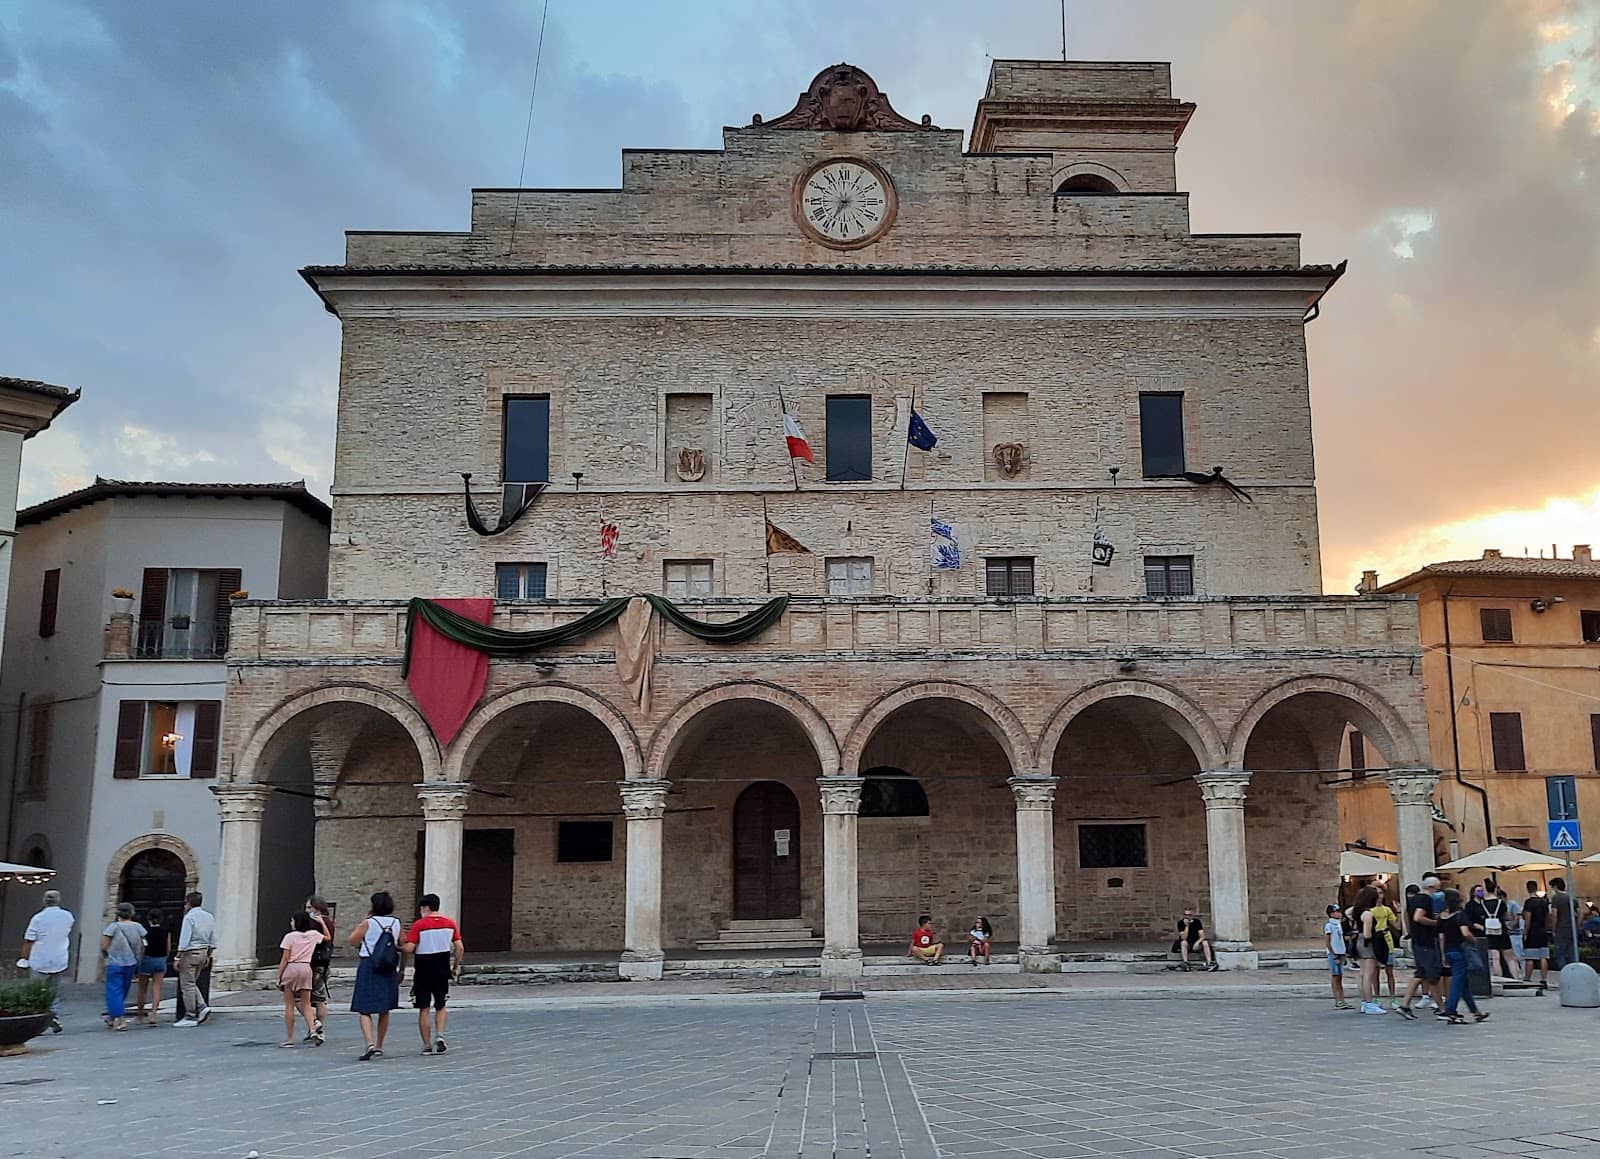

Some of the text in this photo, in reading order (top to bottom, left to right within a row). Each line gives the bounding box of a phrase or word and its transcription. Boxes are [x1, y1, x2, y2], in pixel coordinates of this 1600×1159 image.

[838, 169, 850, 181] XII
[813, 182, 826, 195] X
[863, 184, 875, 193] II
[810, 197, 822, 205] IX
[840, 222, 849, 233] VI
[855, 219, 864, 230] V
